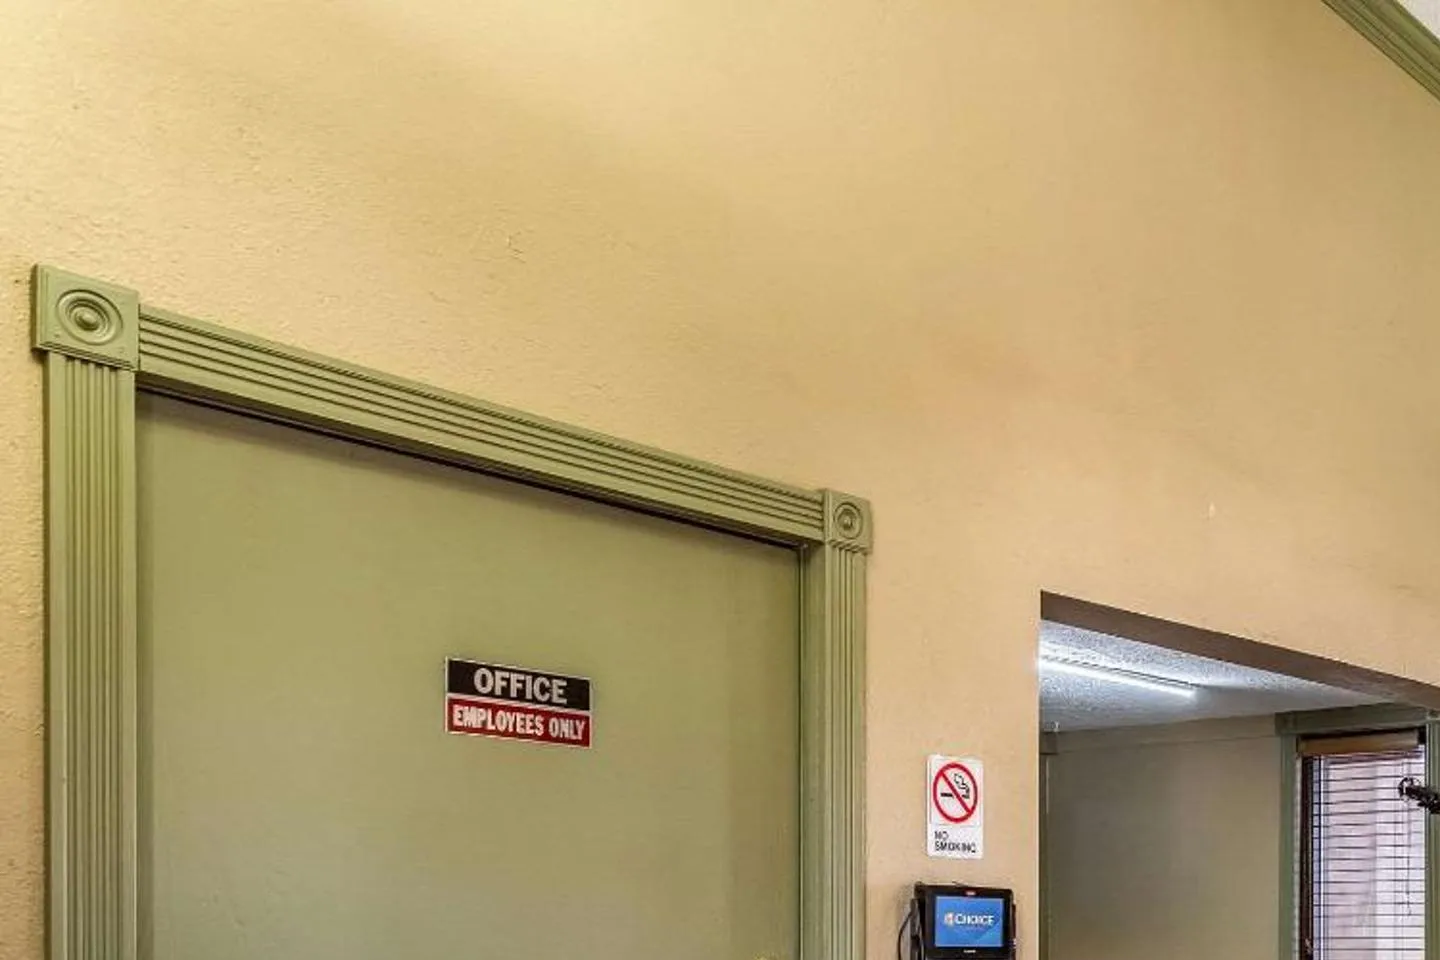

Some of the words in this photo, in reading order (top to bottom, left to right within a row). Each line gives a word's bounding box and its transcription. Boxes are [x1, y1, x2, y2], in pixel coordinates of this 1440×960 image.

[473, 667, 568, 705] OFFICE
[452, 704, 545, 736] EMPLOYEES
[549, 717, 586, 740] ONLY
[934, 830, 949, 840] NO
[934, 841, 976, 853] SMOKING
